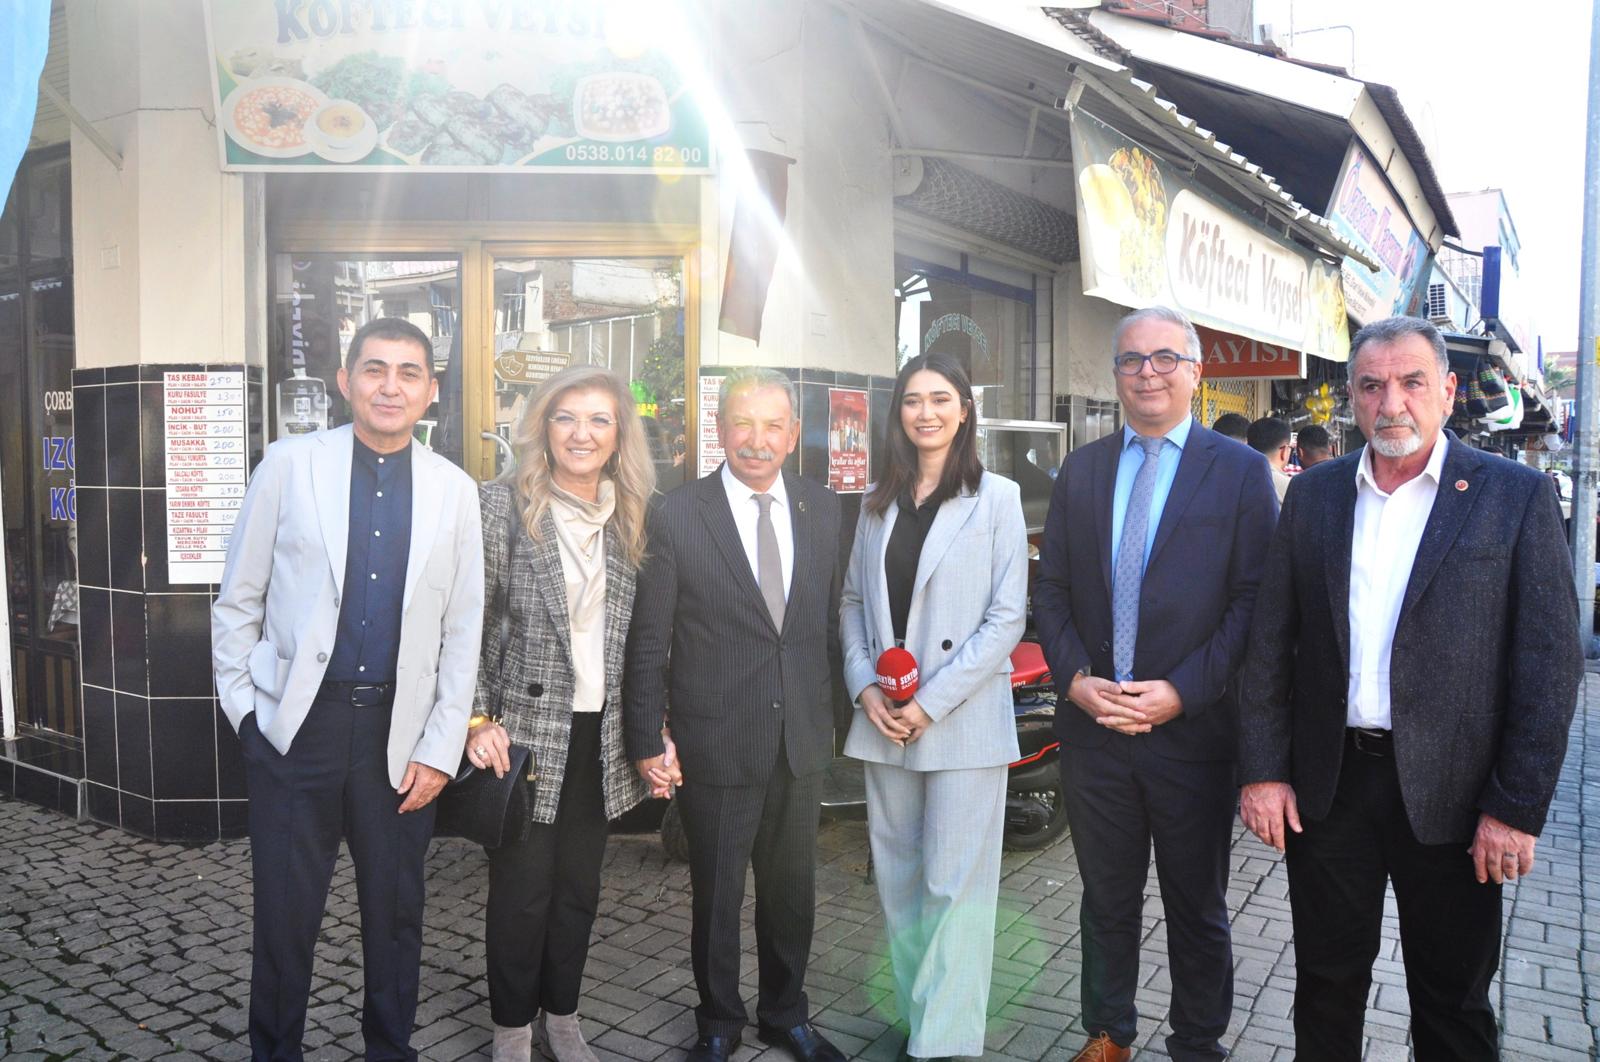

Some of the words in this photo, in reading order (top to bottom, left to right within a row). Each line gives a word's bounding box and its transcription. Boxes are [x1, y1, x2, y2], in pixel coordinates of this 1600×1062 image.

[566, 145, 648, 161] 0538.014
[653, 146, 674, 162] 82
[680, 147, 701, 163] 00
[1178, 212, 1253, 308] Köfteci
[1262, 254, 1305, 327] Veysel
[210, 376, 232, 386] 250
